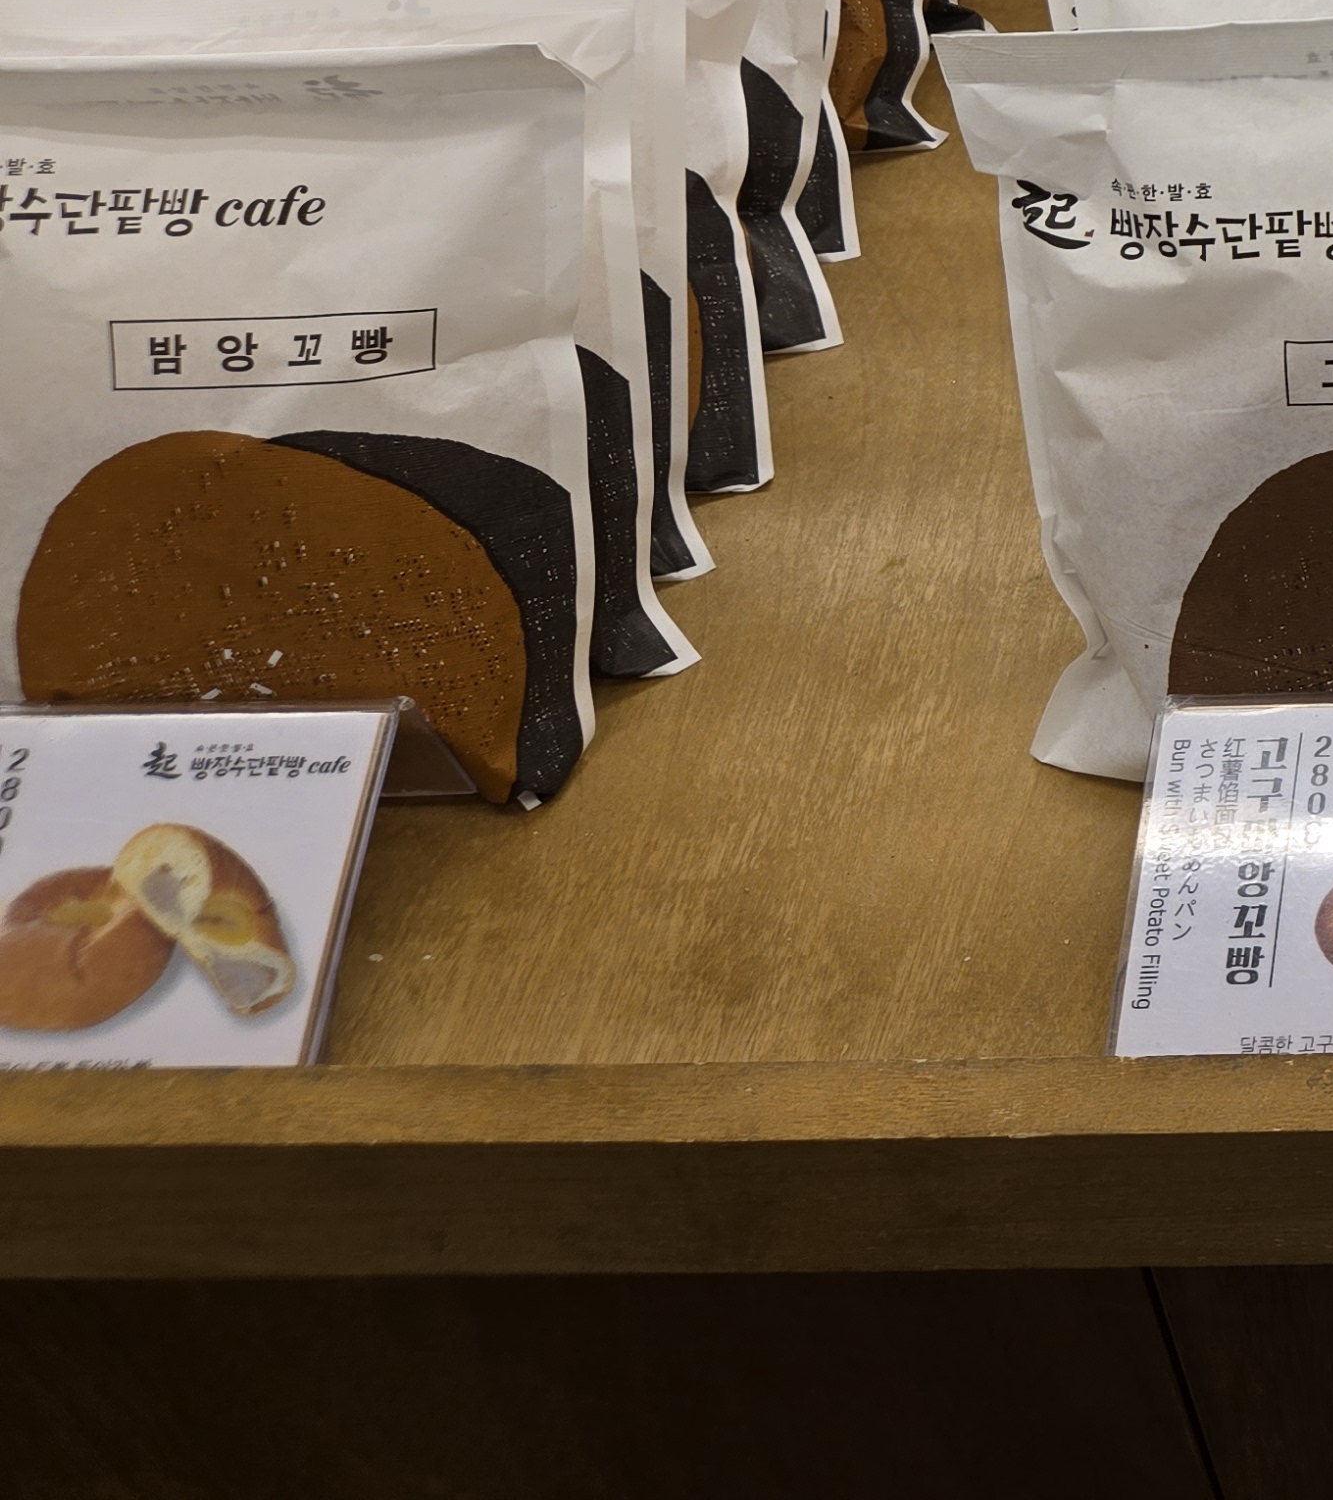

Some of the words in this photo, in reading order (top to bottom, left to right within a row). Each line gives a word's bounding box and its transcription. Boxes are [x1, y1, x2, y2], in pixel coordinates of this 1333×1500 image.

[215, 184, 326, 227] cafe
[190, 755, 306, 780] 빵장수단팥빵
[308, 756, 351, 775] cafe
[1169, 739, 1192, 773] Bun
[1165, 780, 1184, 818] with
[1143, 888, 1170, 947] Potato
[1131, 954, 1161, 1011] Filling
